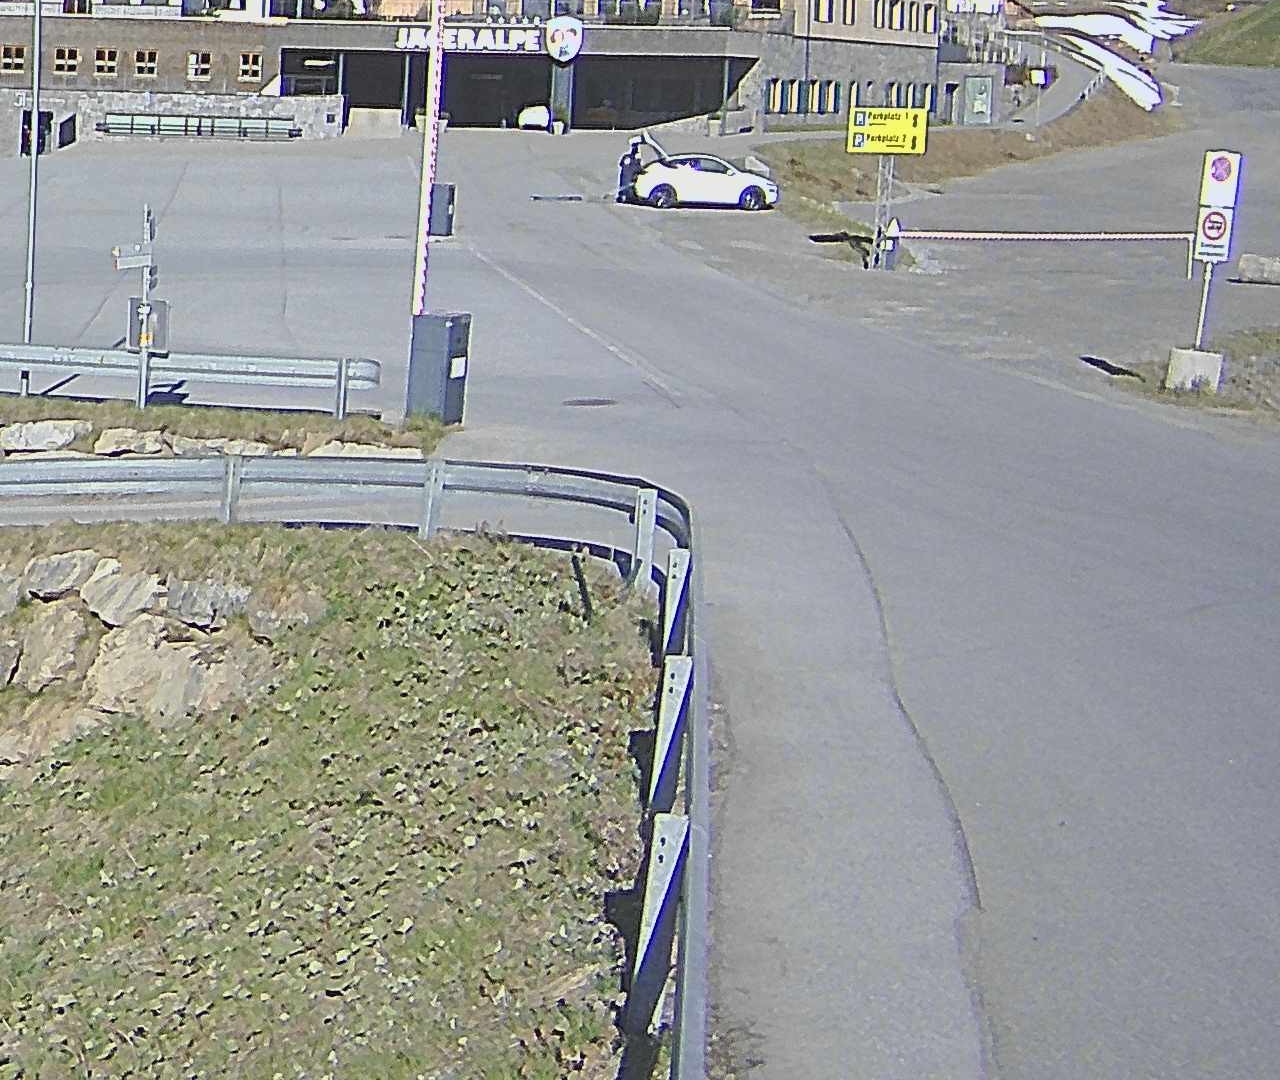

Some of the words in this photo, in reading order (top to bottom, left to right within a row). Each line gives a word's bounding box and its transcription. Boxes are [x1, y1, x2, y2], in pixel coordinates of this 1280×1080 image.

[394, 27, 541, 51] JÄERALPE
[868, 111, 901, 121] Parkplatz
[867, 133, 899, 143] Parkplatz
